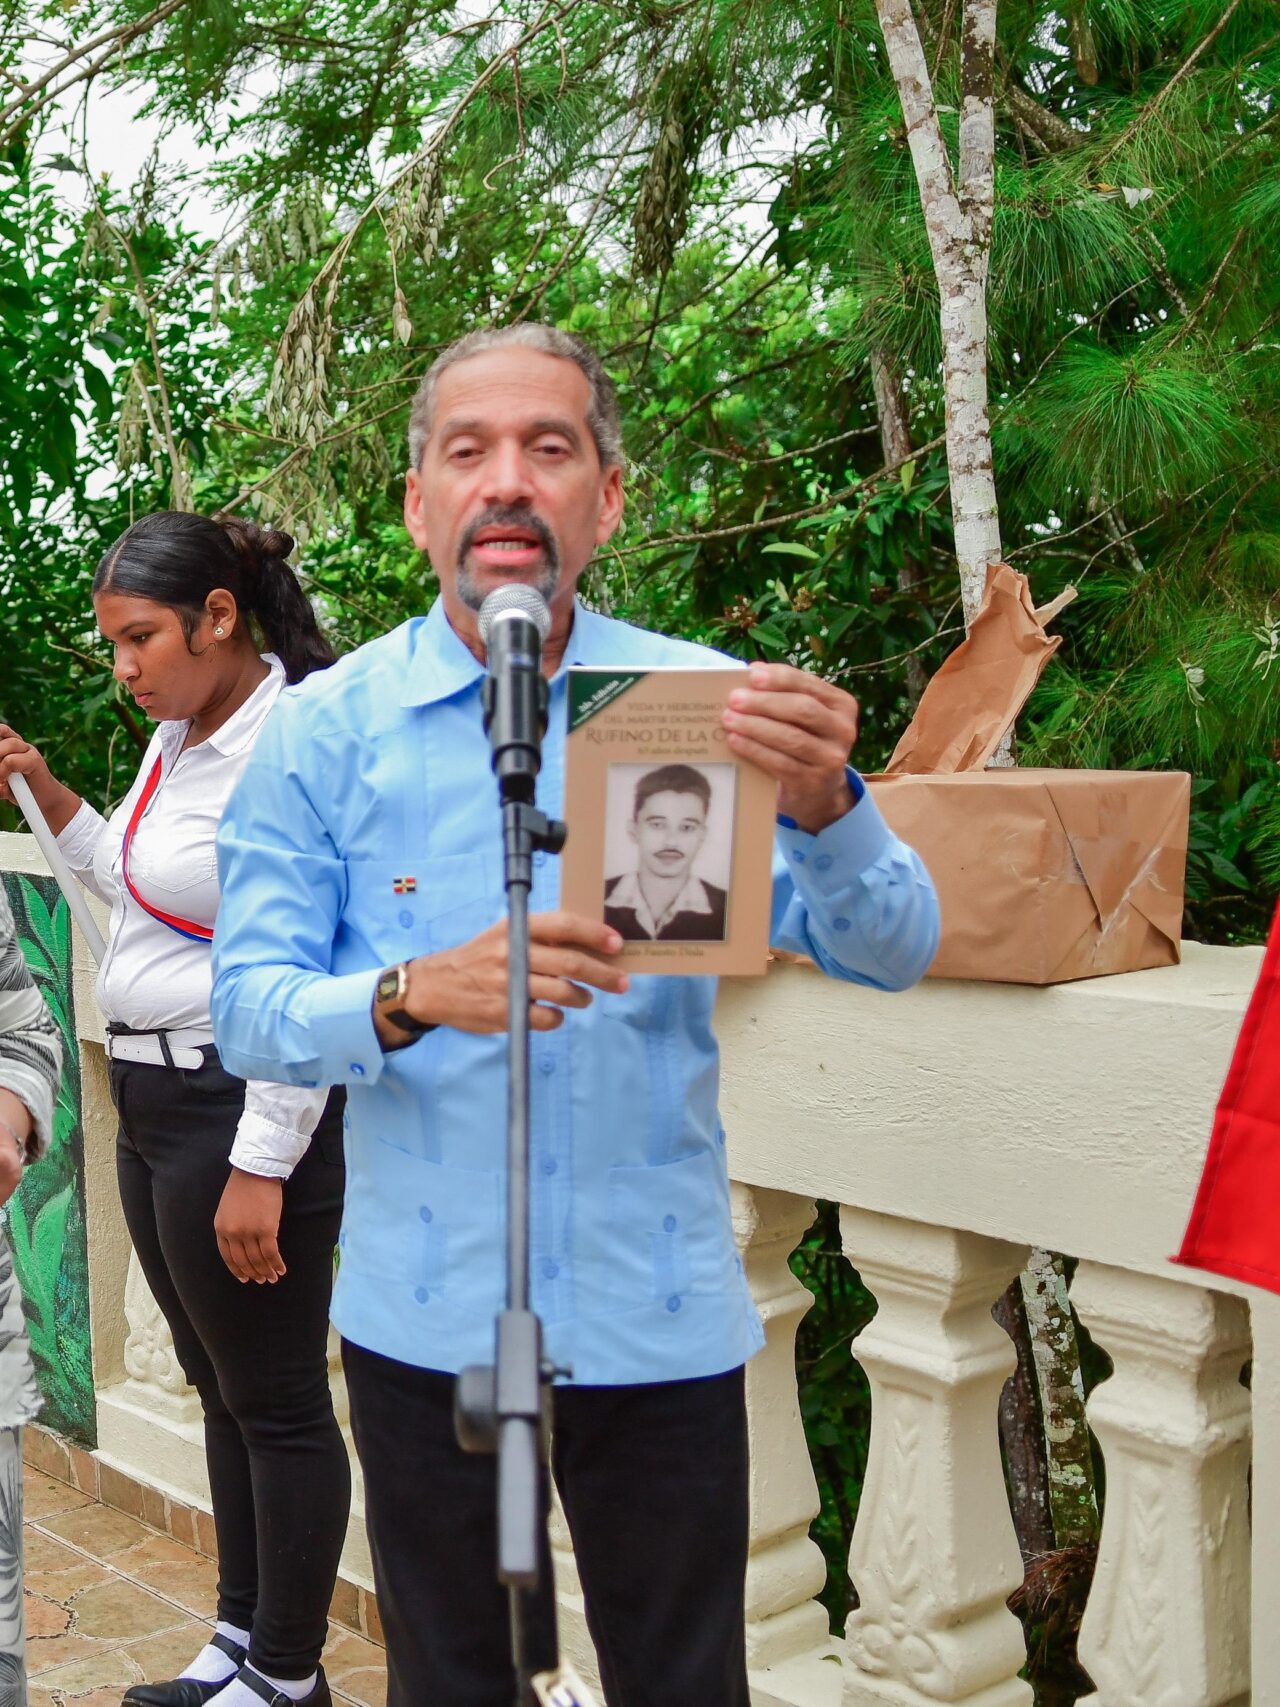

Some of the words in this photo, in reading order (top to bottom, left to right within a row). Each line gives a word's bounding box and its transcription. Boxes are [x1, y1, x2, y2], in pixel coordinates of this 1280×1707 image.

[627, 702, 654, 711] VIDA
[657, 702, 665, 711] Y
[585, 728, 654, 744] RUFINO
